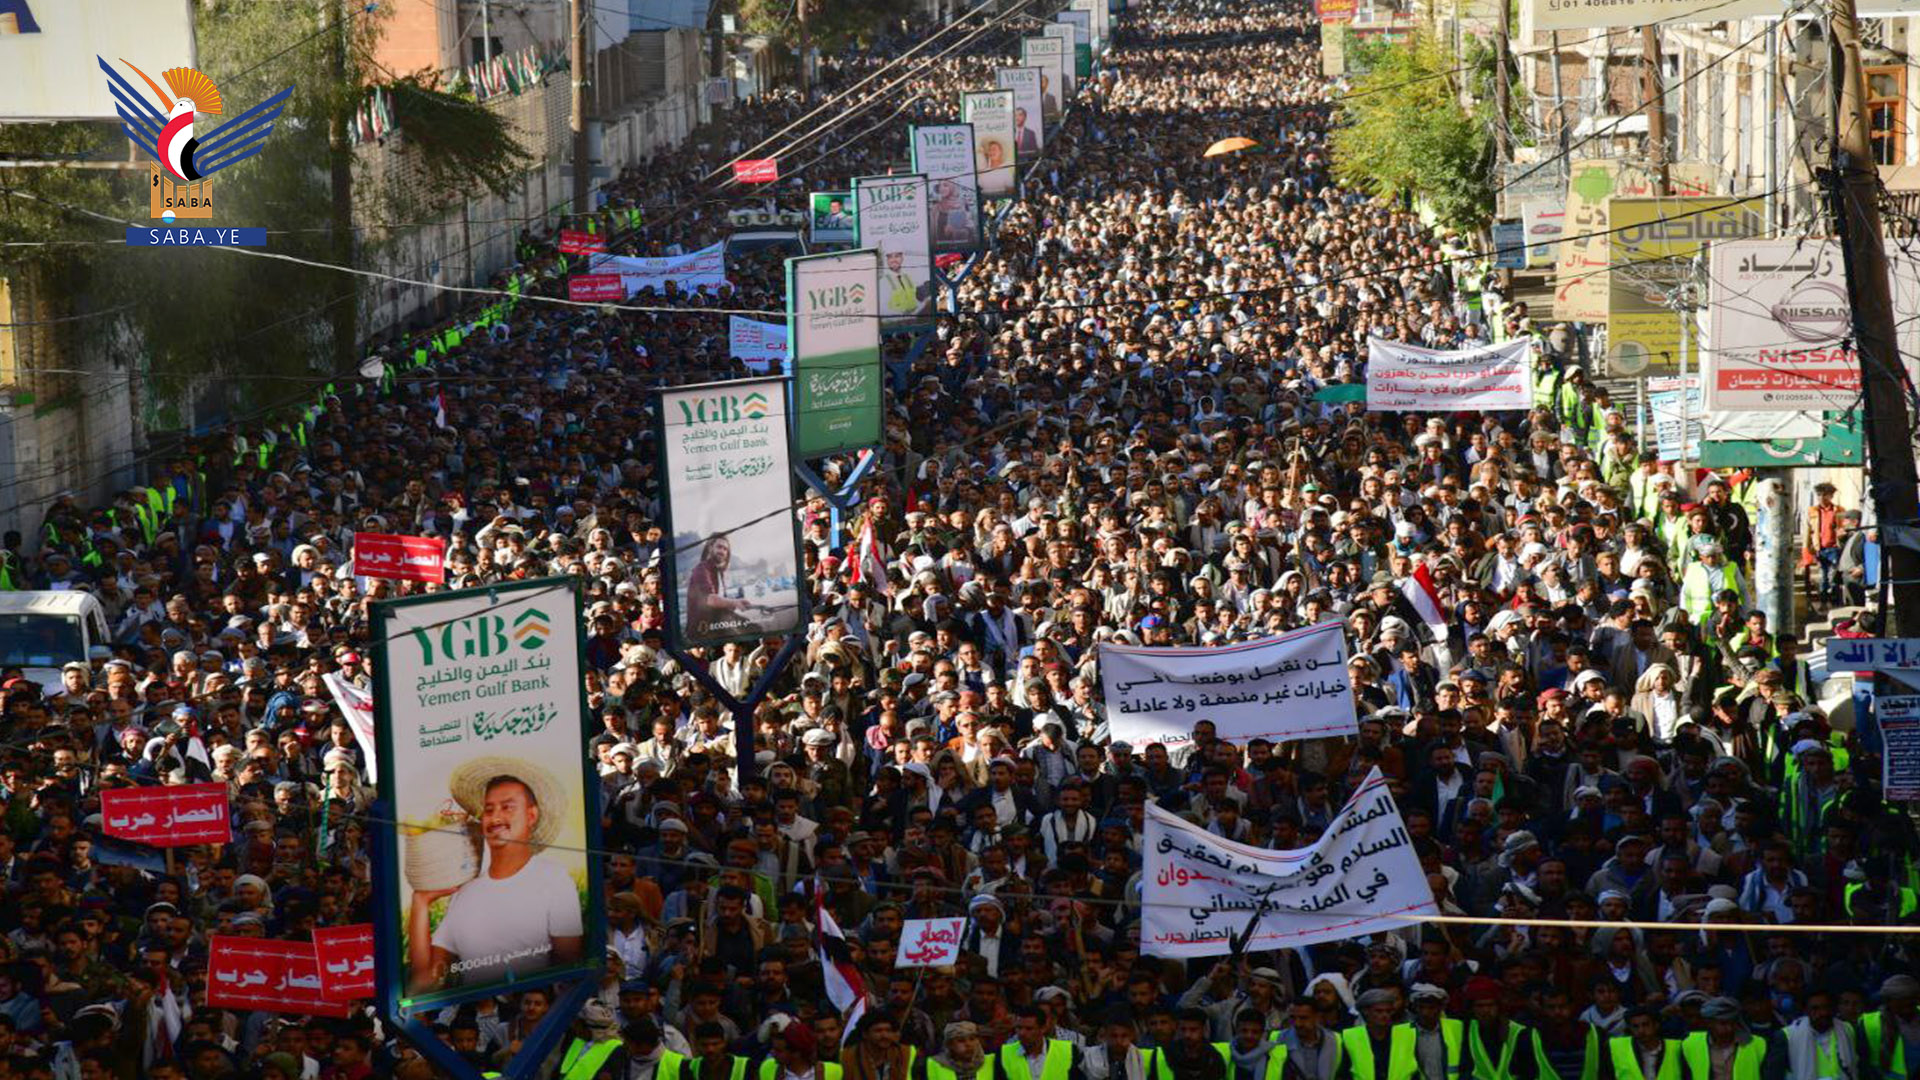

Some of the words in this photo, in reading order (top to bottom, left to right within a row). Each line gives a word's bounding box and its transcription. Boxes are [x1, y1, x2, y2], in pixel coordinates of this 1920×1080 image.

[971, 97, 996, 109] YGB
[922, 132, 953, 146] YGB
[868, 185, 901, 203] YGB
[808, 285, 848, 310] YGB
[1780, 307, 1850, 318] NISSAN
[1728, 374, 1768, 388] نيسان
[678, 395, 741, 427] YGB
[682, 442, 717, 454] Yemen
[720, 438, 740, 451] Gulf
[743, 437, 768, 448] Bank
[359, 551, 392, 563] حرب
[395, 551, 440, 567] الحصار
[411, 614, 509, 667] YGB
[1305, 650, 1342, 672] لن
[1834, 642, 1874, 663] الله
[416, 666, 473, 691] والخليج
[476, 658, 518, 681] اليمن
[1248, 660, 1302, 681] نقبل
[418, 688, 471, 707] Yemen
[475, 680, 505, 698] Gulf
[511, 674, 550, 693] Bank
[1116, 672, 1164, 694] في
[1294, 679, 1347, 700] خيارات
[1172, 694, 1196, 712] ولا
[1200, 690, 1259, 707] منصفة
[1262, 684, 1291, 705] غير
[1120, 697, 1169, 714] عادلة
[110, 813, 155, 831] حرب
[162, 803, 223, 828] الحصار
[1156, 833, 1233, 871] تحقيق
[1341, 826, 1409, 874] السلام
[1305, 863, 1335, 887] هو
[1356, 867, 1390, 901] في
[450, 954, 500, 974] 8000414
[215, 968, 268, 988] حرب
[274, 968, 321, 991] صار
